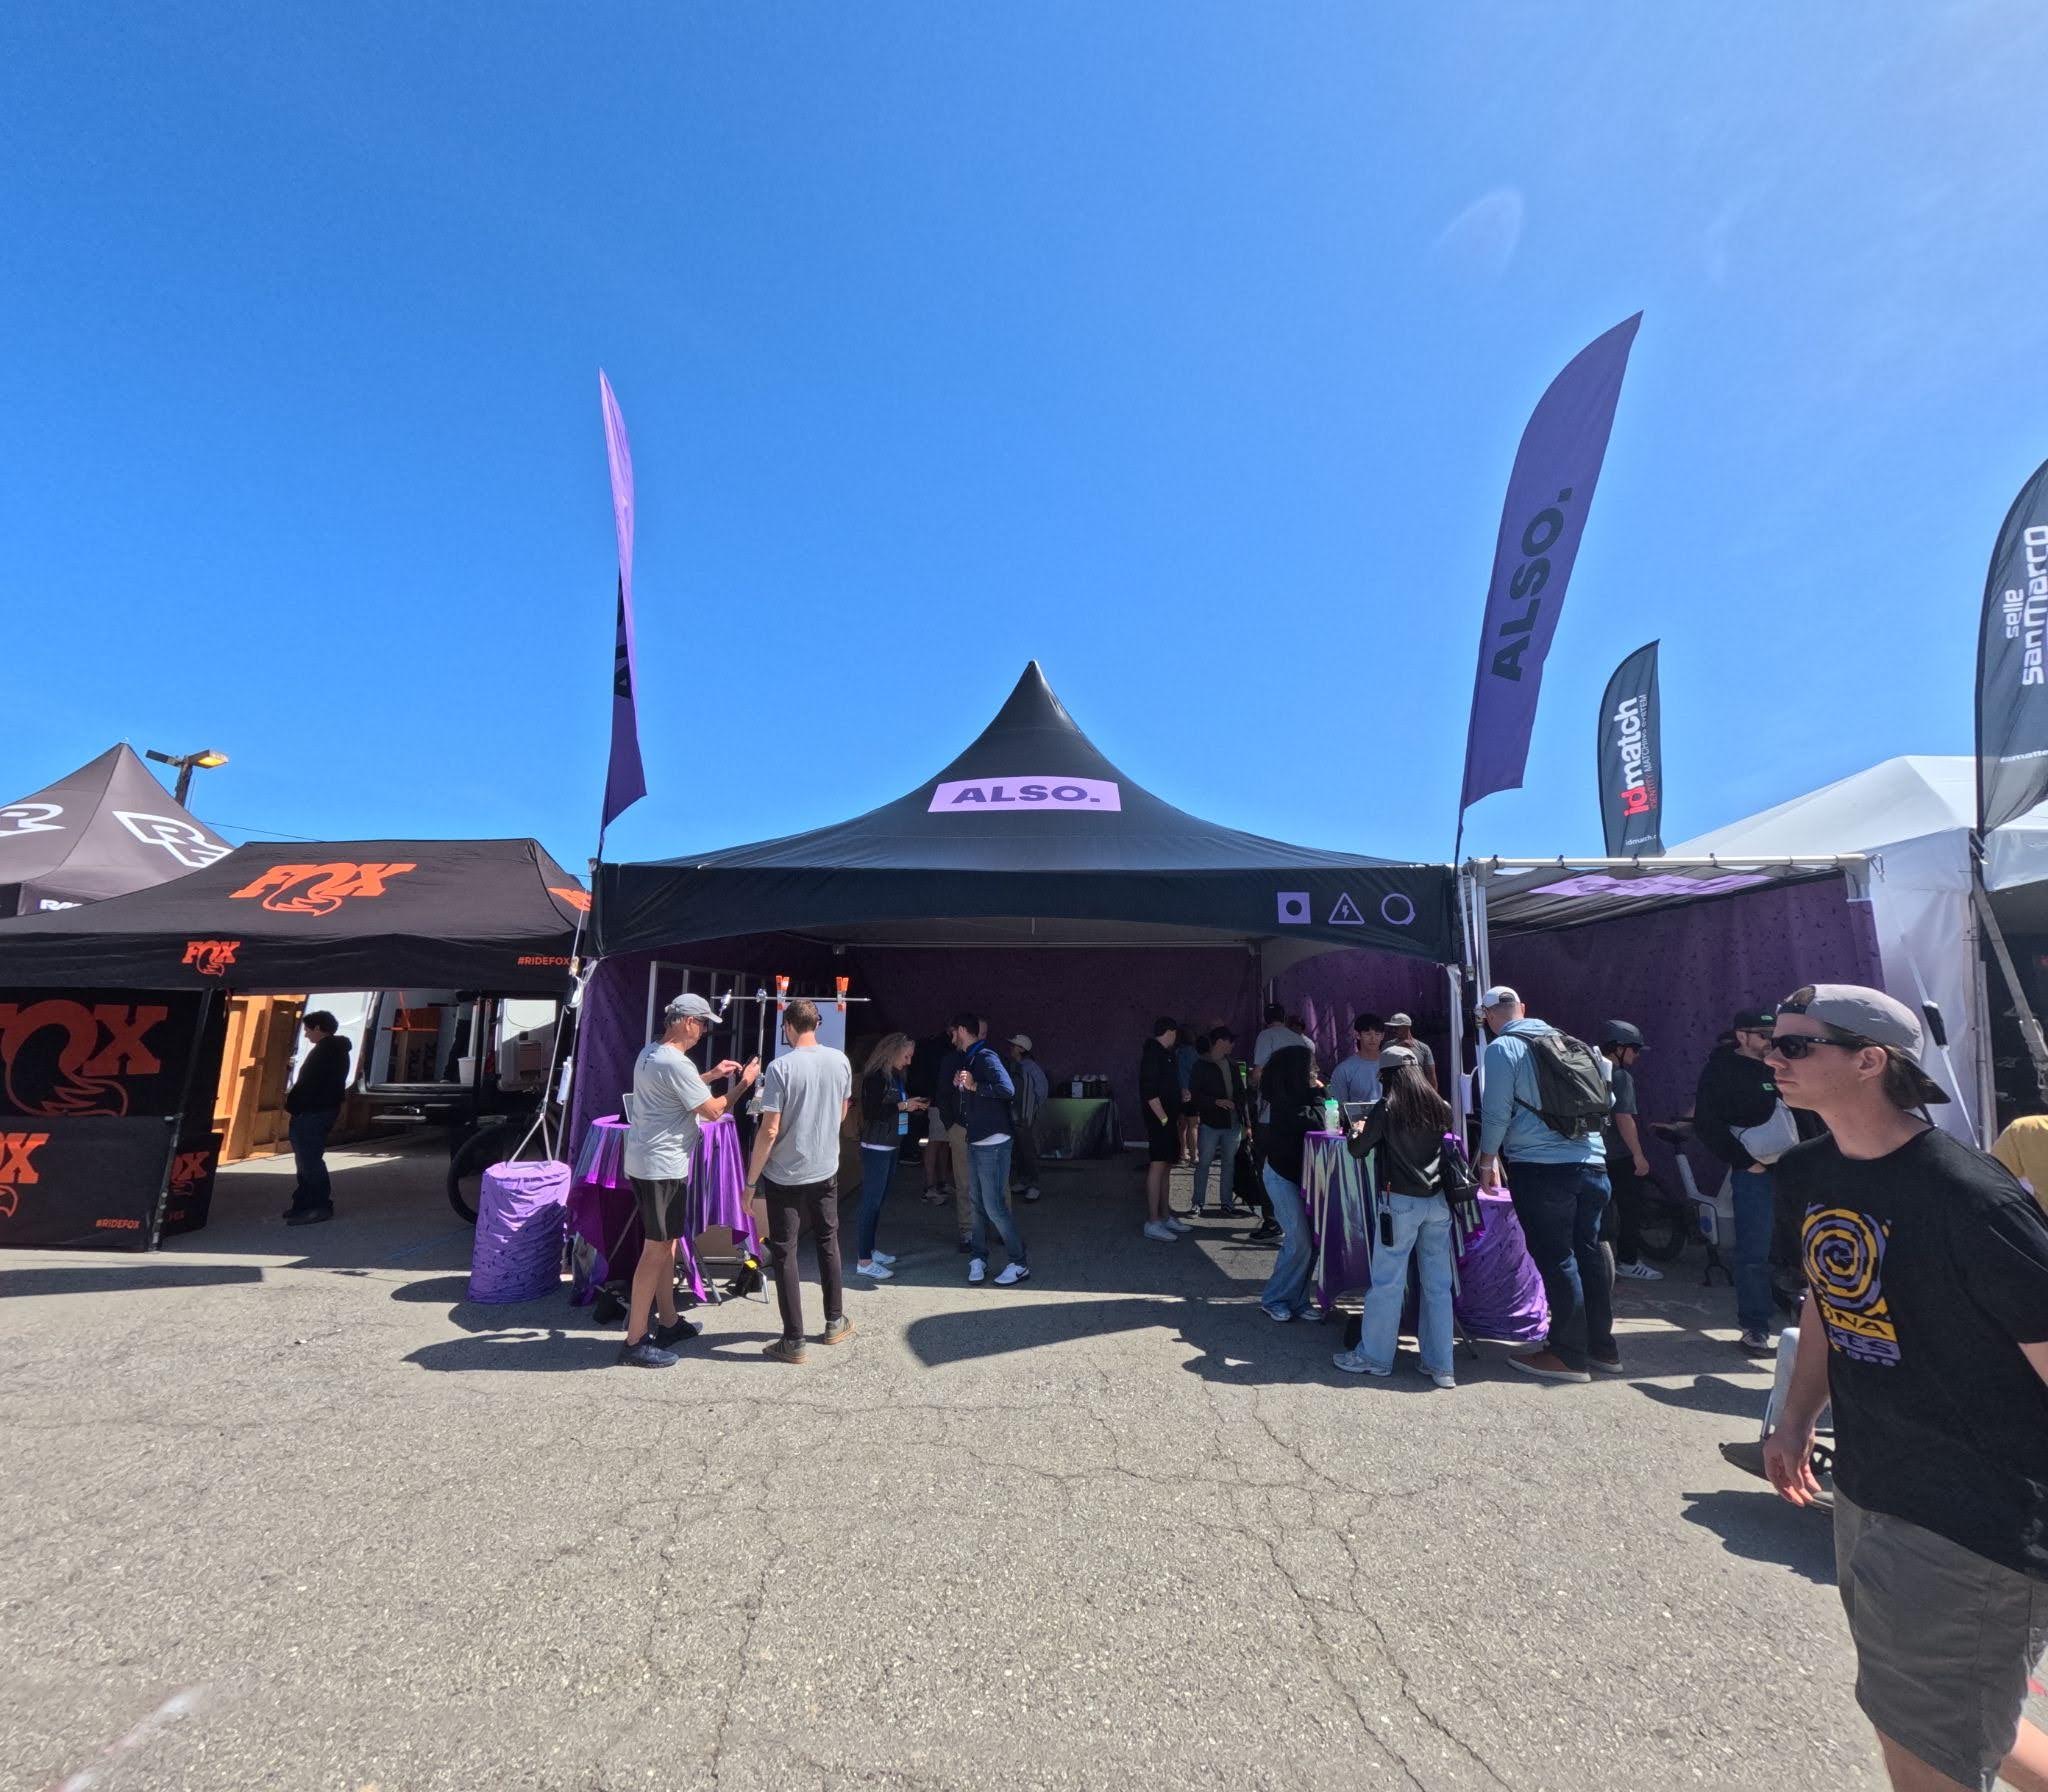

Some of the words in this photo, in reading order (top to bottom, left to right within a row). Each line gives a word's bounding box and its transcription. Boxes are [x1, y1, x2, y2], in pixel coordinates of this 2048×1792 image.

[1491, 487, 1573, 681] ALSO.
[2003, 588, 2024, 639] selle
[1614, 697, 1650, 816] idmatch
[1639, 729, 1652, 772] MATCHING
[952, 784, 1100, 804] ALSO.
[228, 862, 417, 917] FOX
[182, 940, 240, 977] FOX
[517, 956, 571, 966] #RIDEFOX
[95, 1218, 140, 1229] #RIDEFOX
